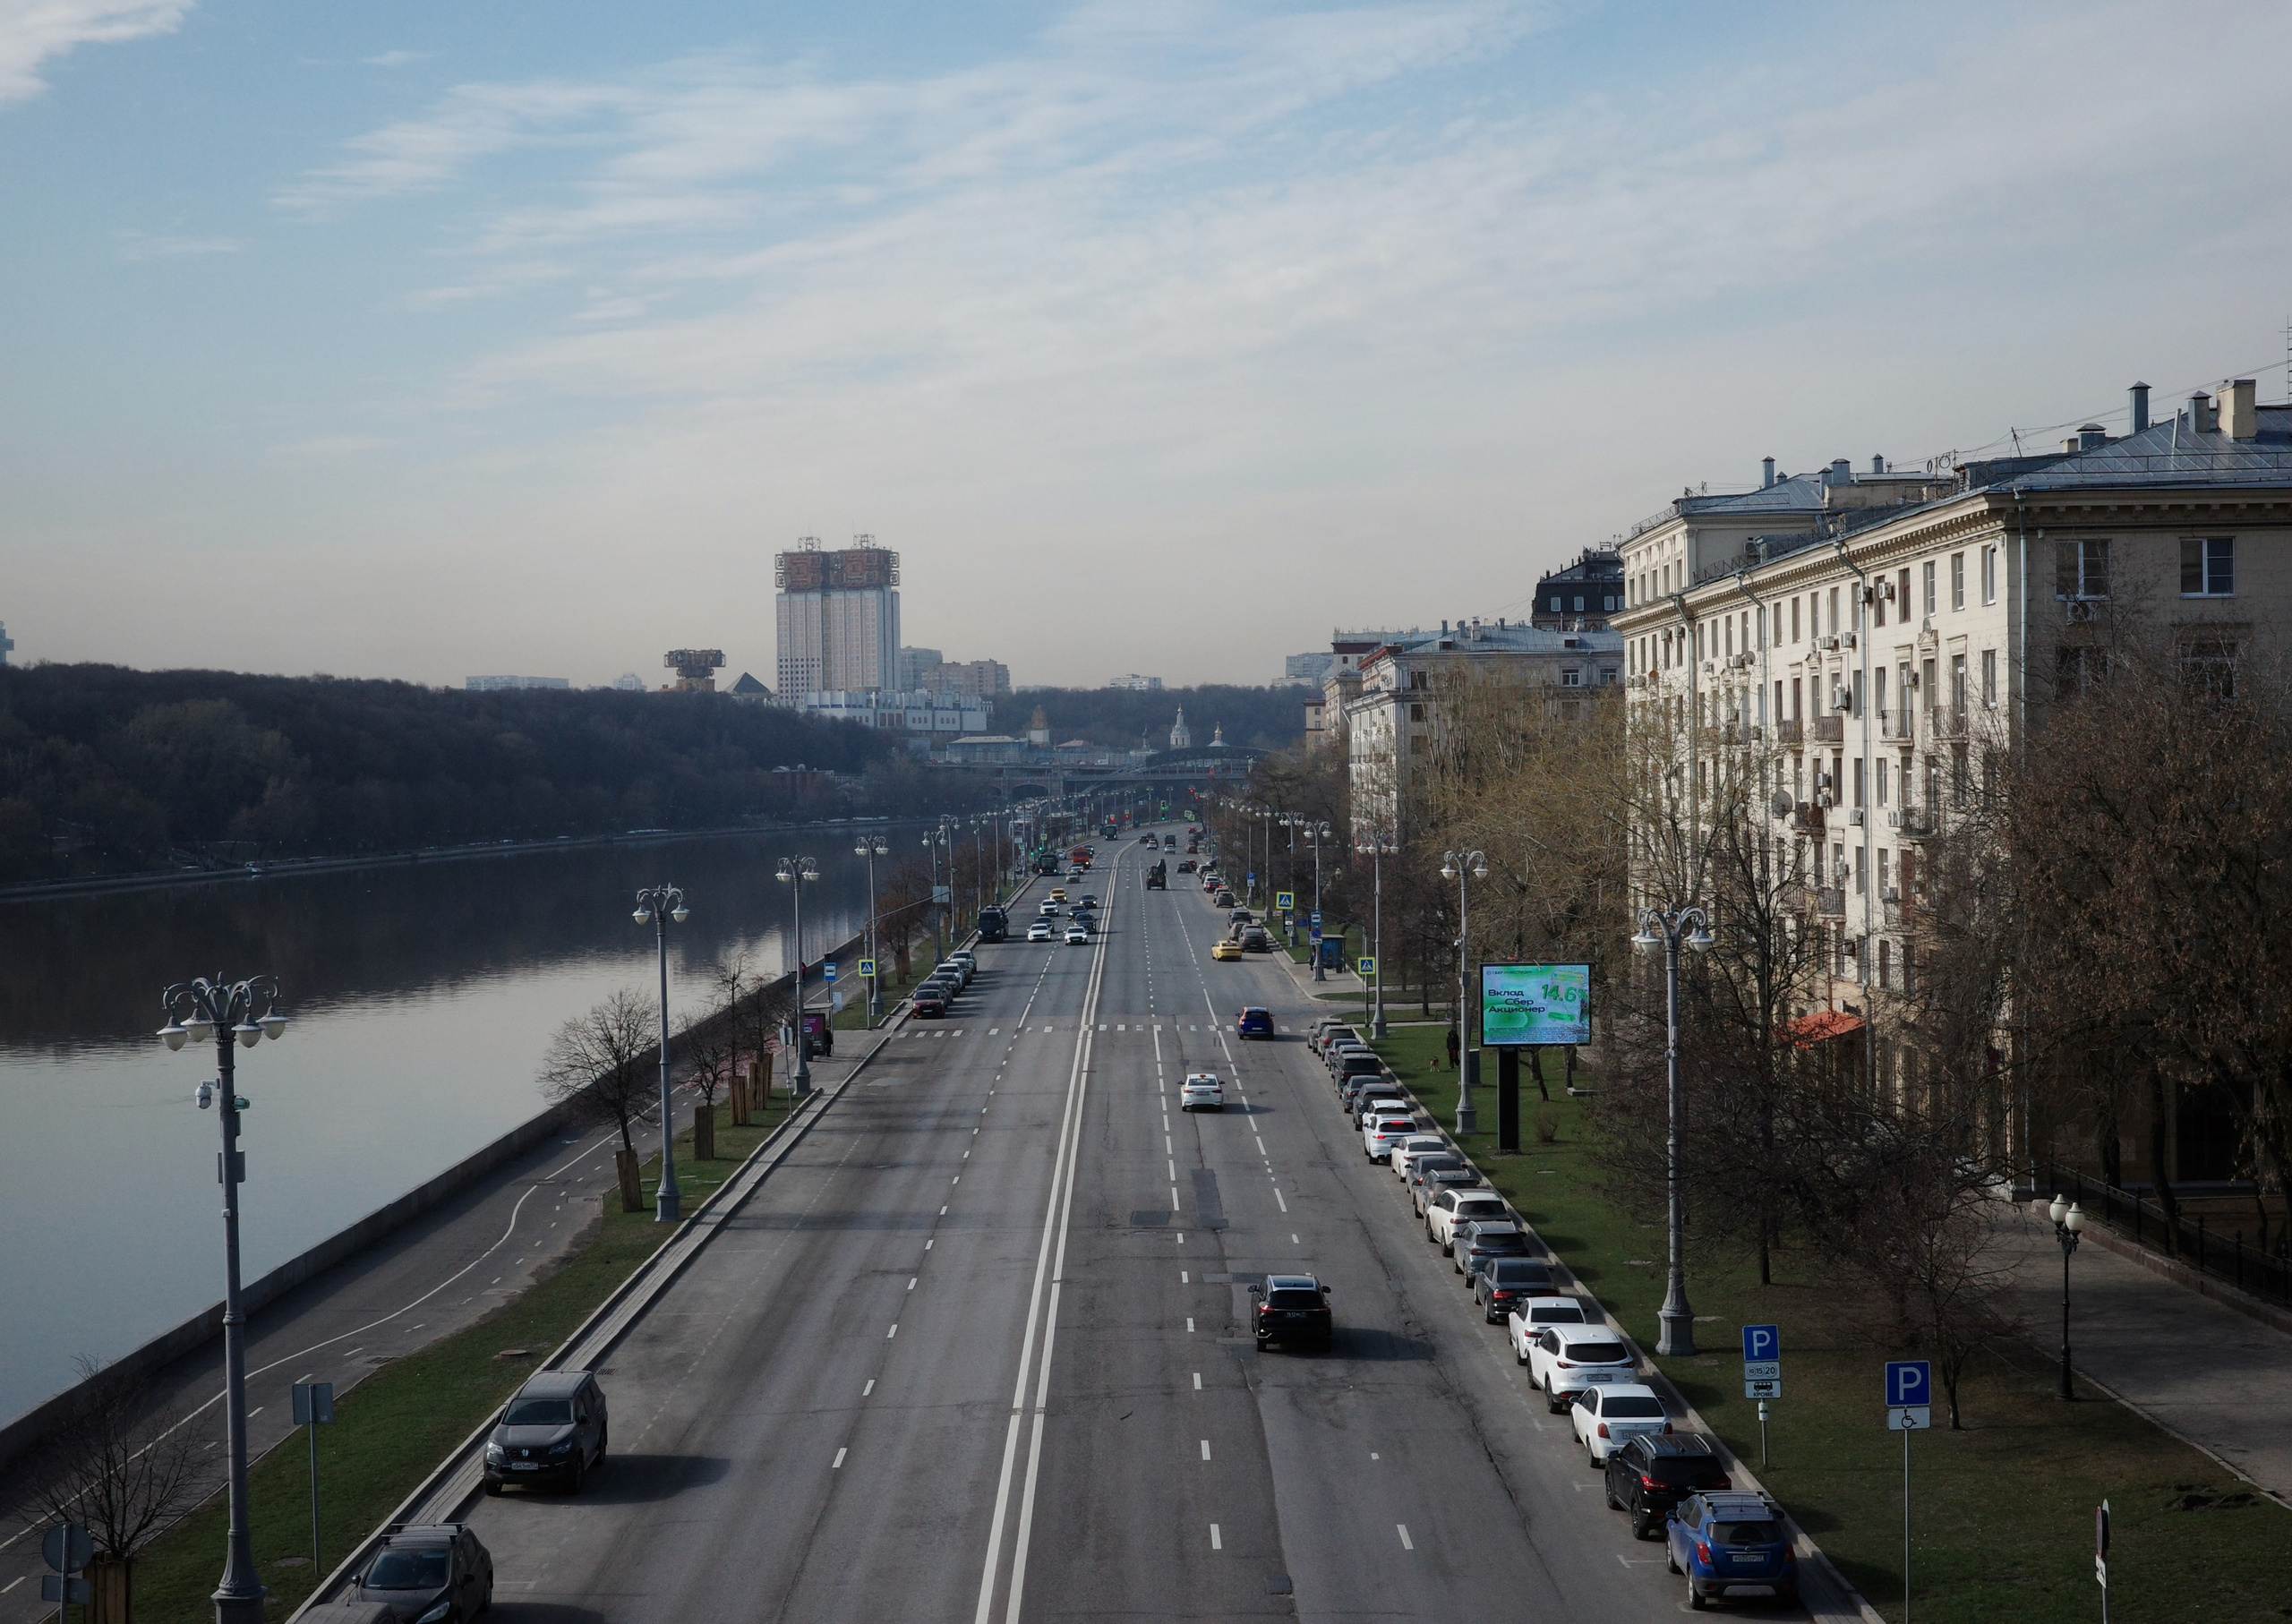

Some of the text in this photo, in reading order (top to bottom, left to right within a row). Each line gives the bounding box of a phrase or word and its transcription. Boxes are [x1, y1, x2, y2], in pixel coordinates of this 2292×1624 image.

[1752, 1330, 1771, 1356] P
[1766, 1366, 1775, 1374] 20
[1898, 1367, 1922, 1400] P
